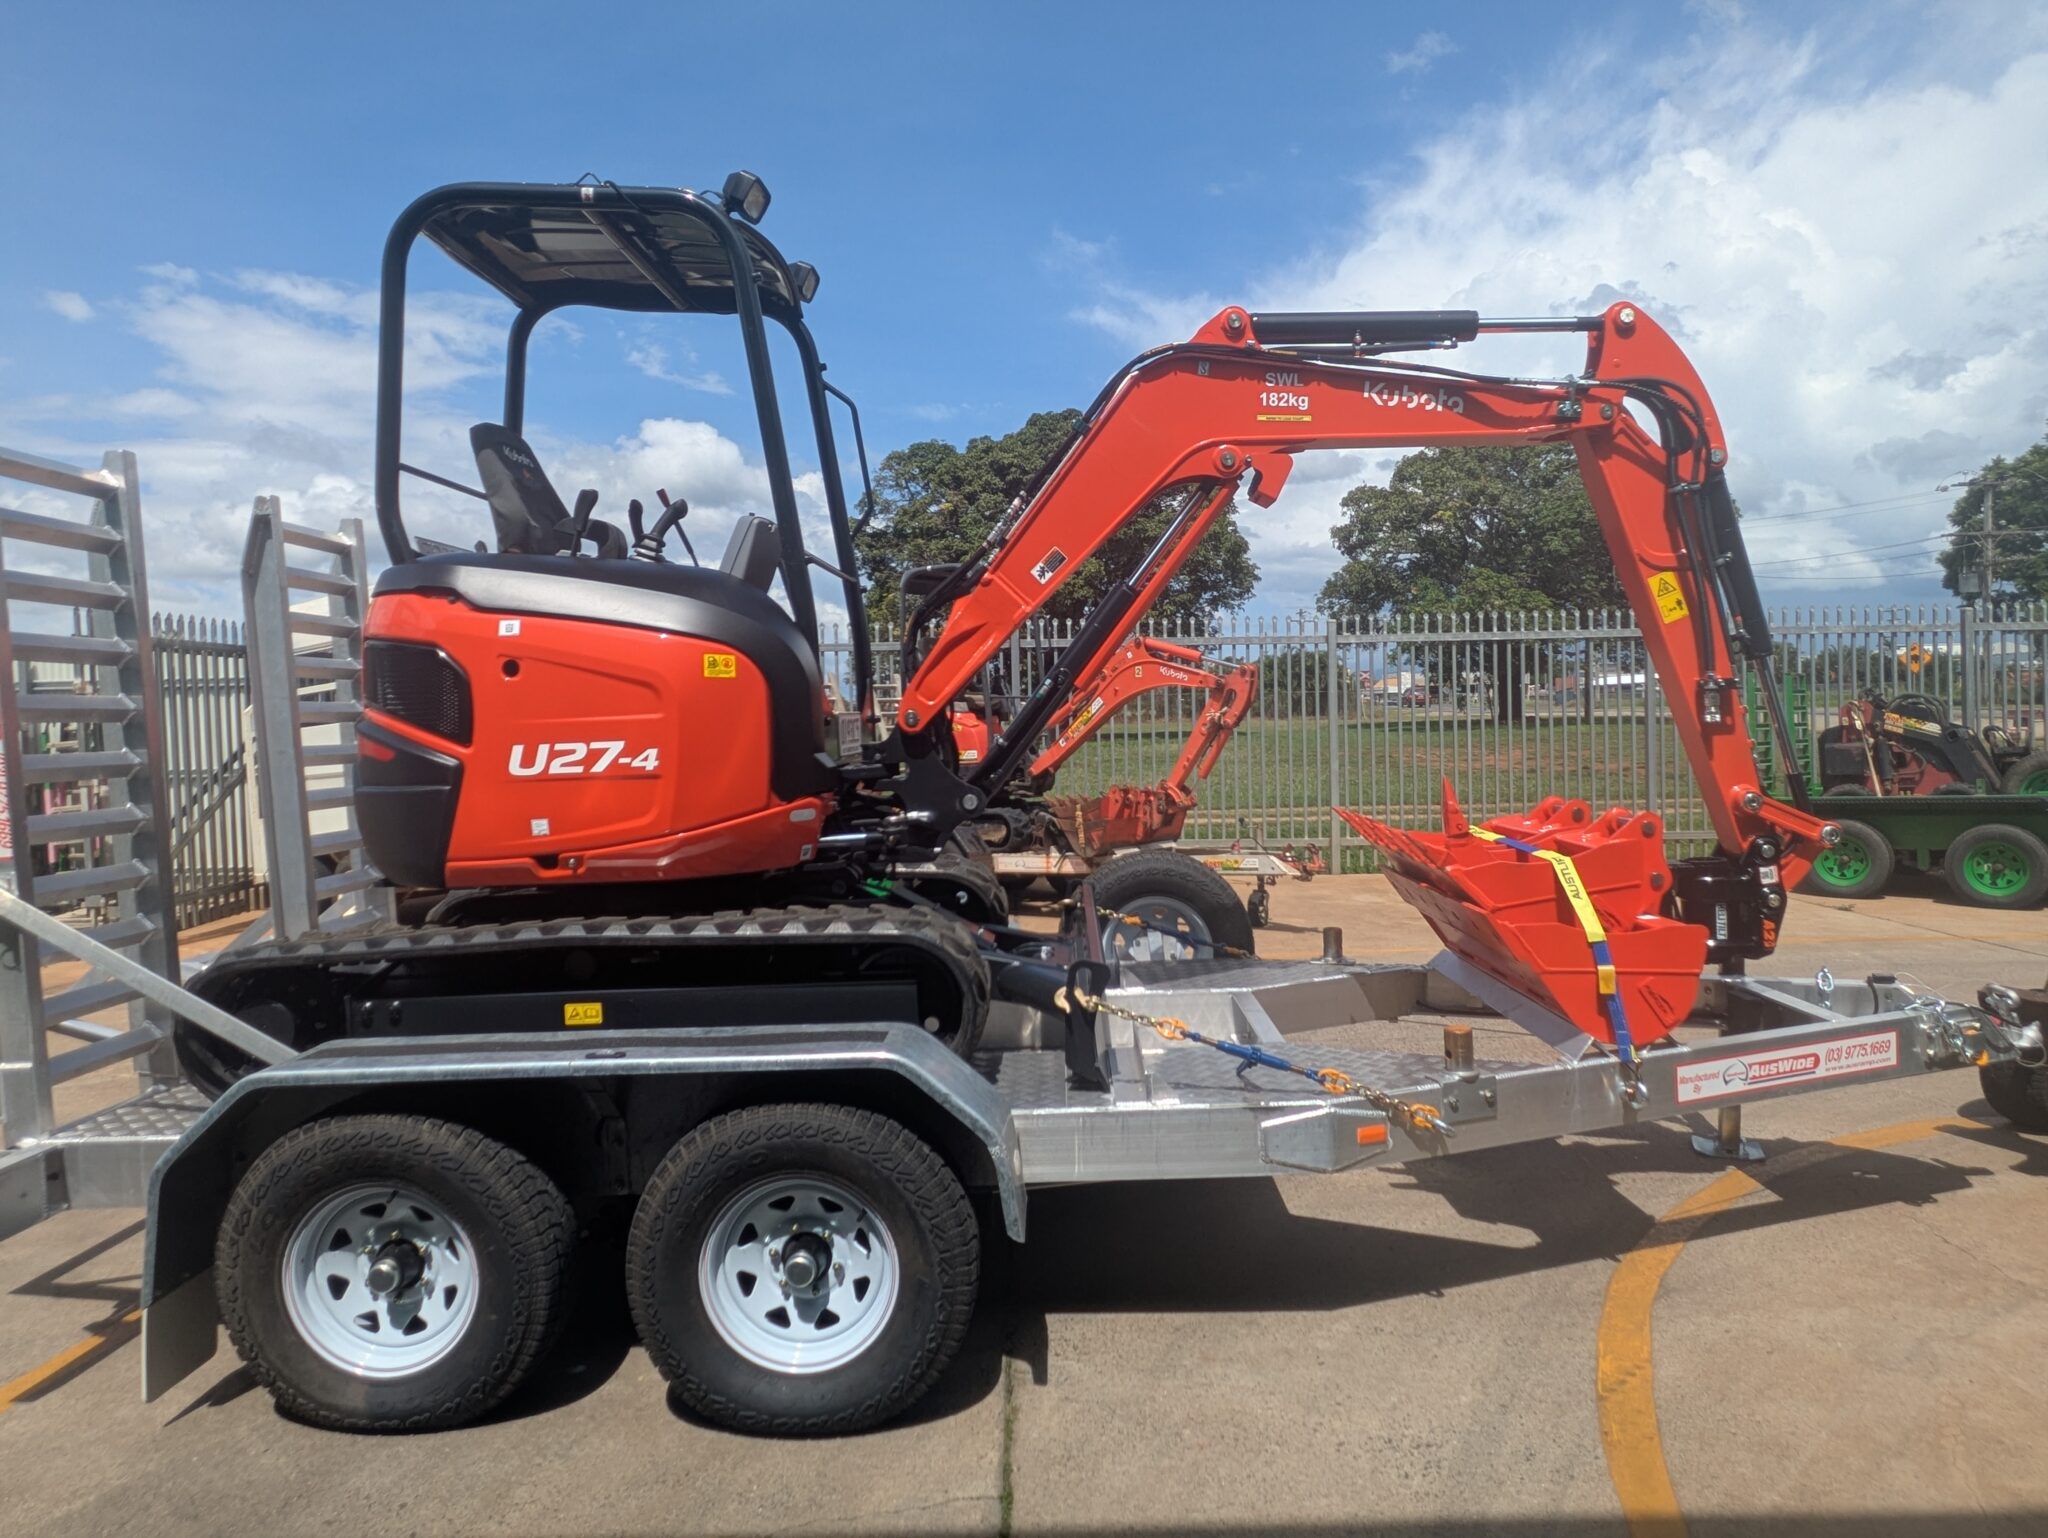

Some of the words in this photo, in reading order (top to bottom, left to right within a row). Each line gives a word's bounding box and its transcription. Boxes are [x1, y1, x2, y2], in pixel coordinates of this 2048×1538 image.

[1265, 372, 1304, 387] SWL
[1259, 391, 1309, 411] 182kg
[1363, 380, 1464, 414] Kubota
[1159, 665, 1188, 681] Kubota
[508, 740, 660, 776] U27-4
[1825, 1045, 1843, 1066] (03)
[1844, 1039, 1891, 1060] 9775.1669
[1679, 1070, 1720, 1085] Manufactured
